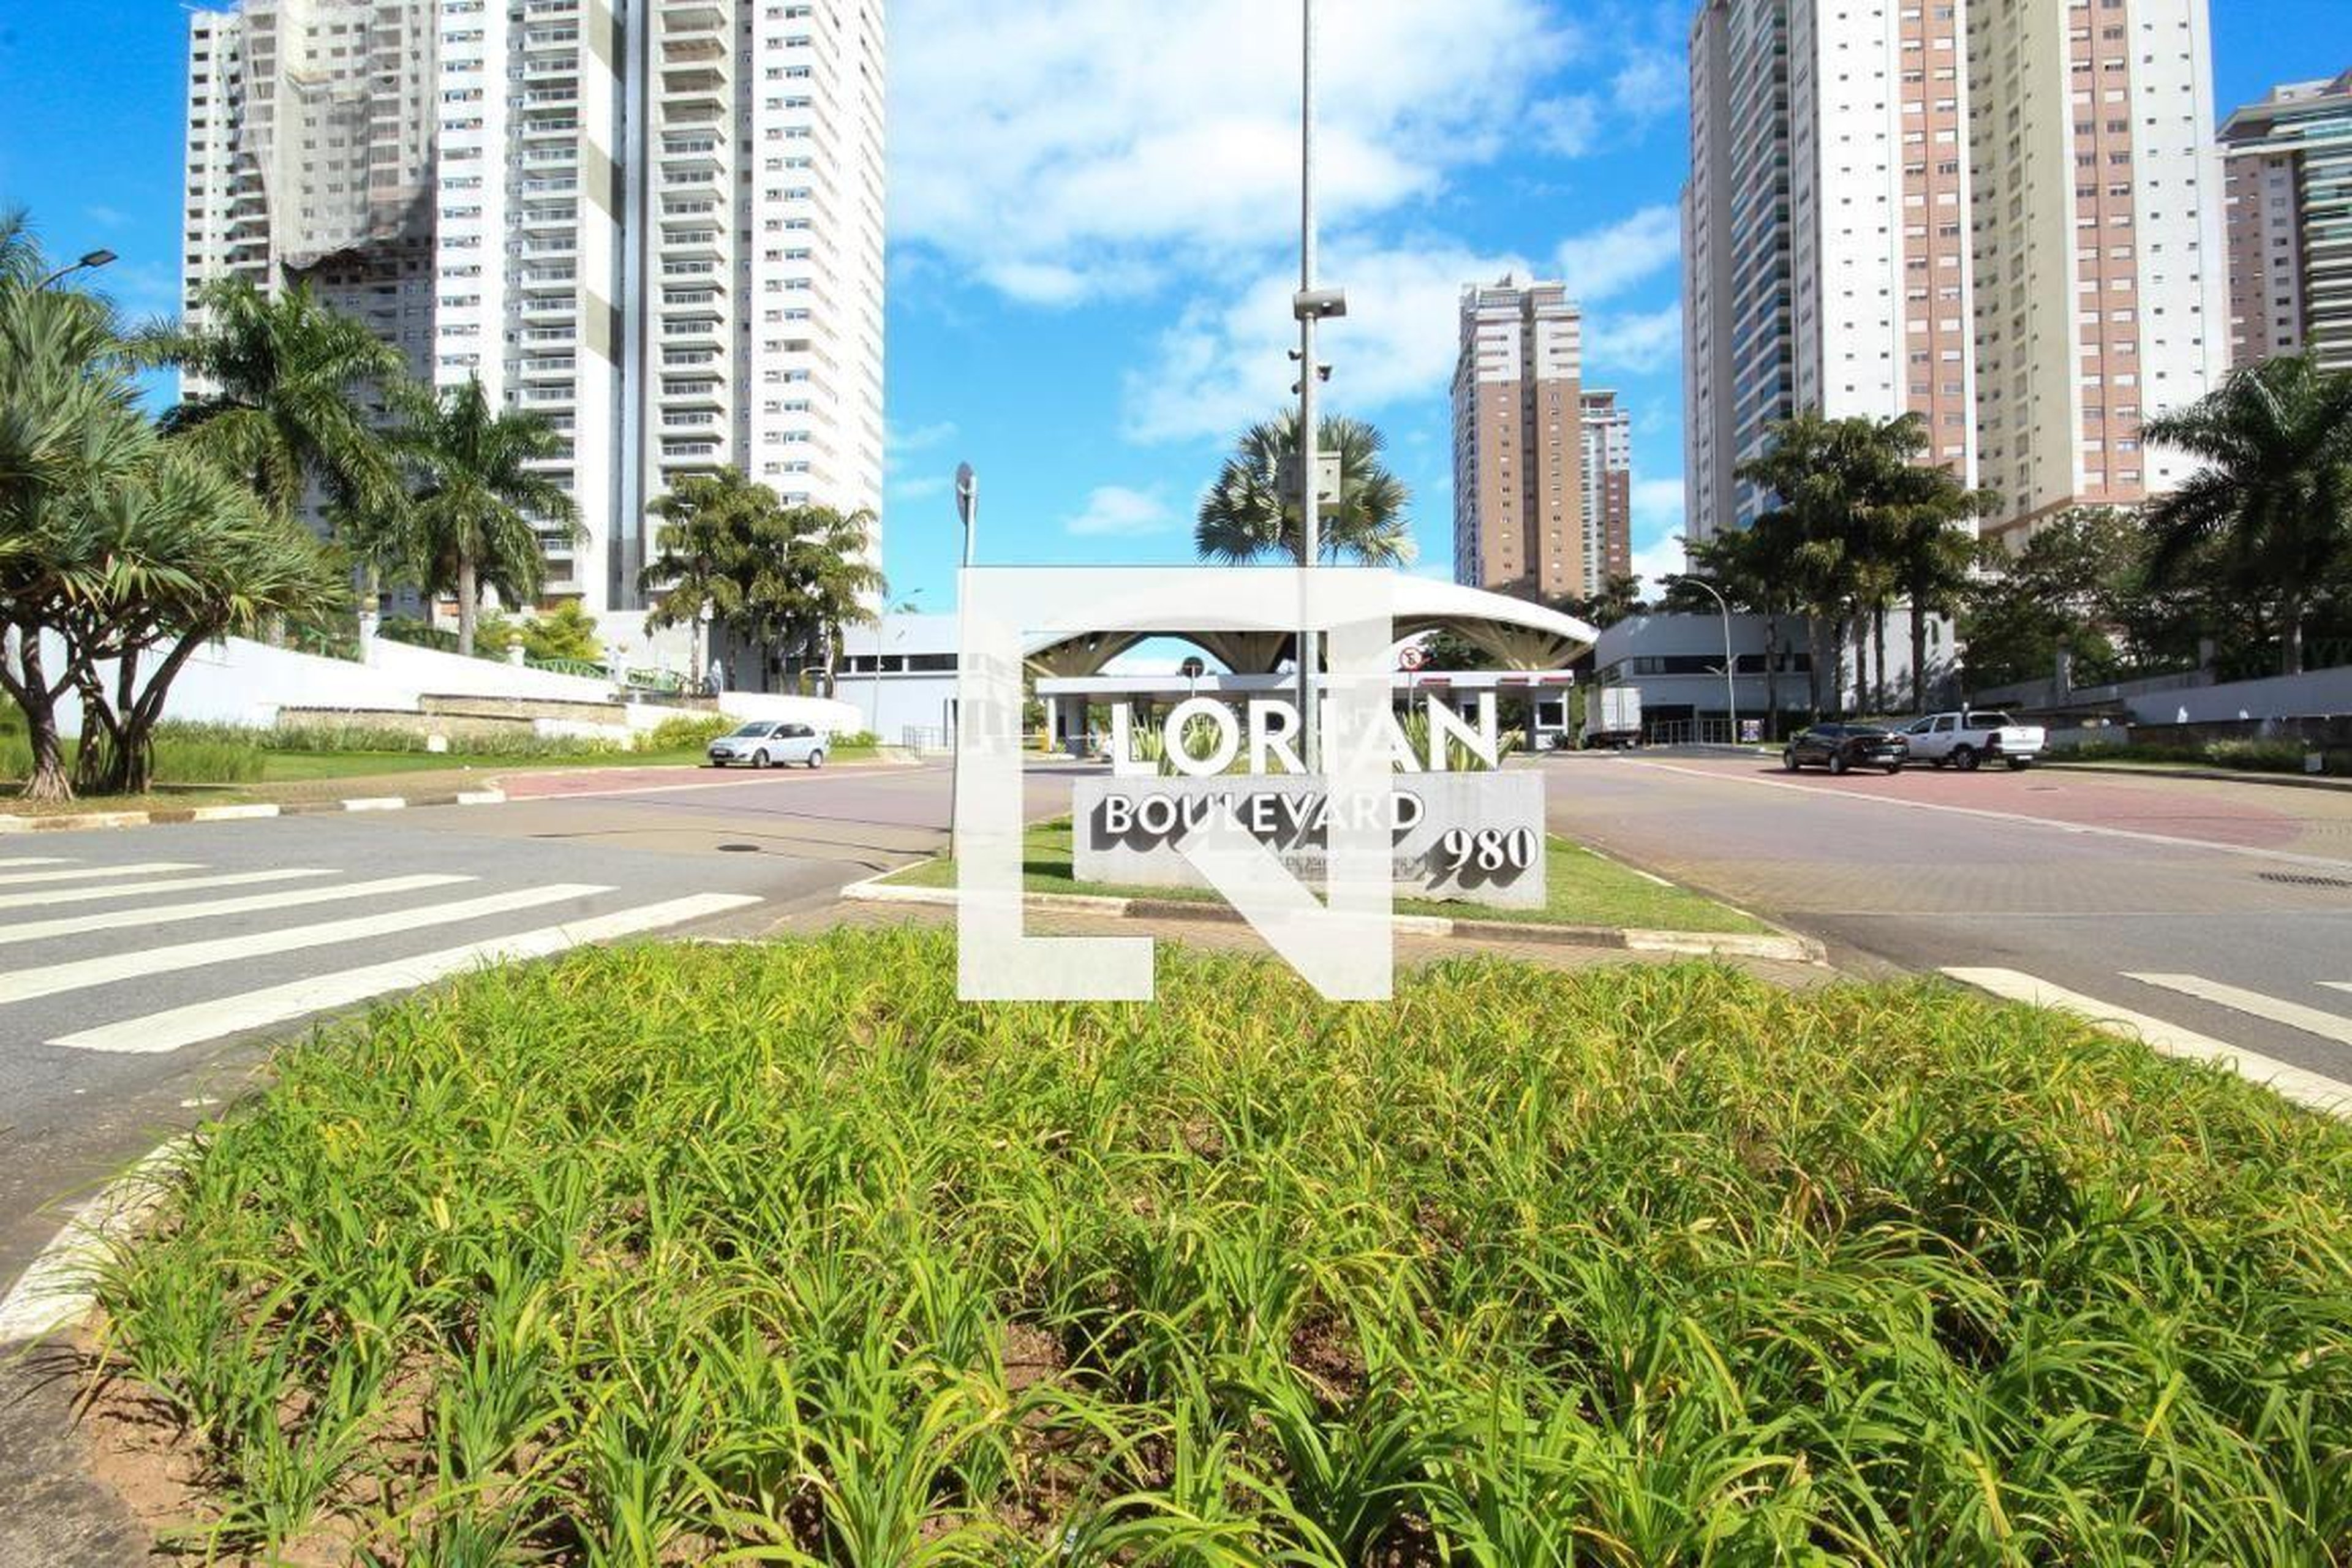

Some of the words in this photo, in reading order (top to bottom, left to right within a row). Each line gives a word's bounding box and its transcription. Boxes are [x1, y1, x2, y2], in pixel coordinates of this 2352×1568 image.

[1112, 693, 1498, 775] LORIAN
[1105, 793, 1425, 834] BOULEVARD
[1443, 828, 1538, 871] 980
